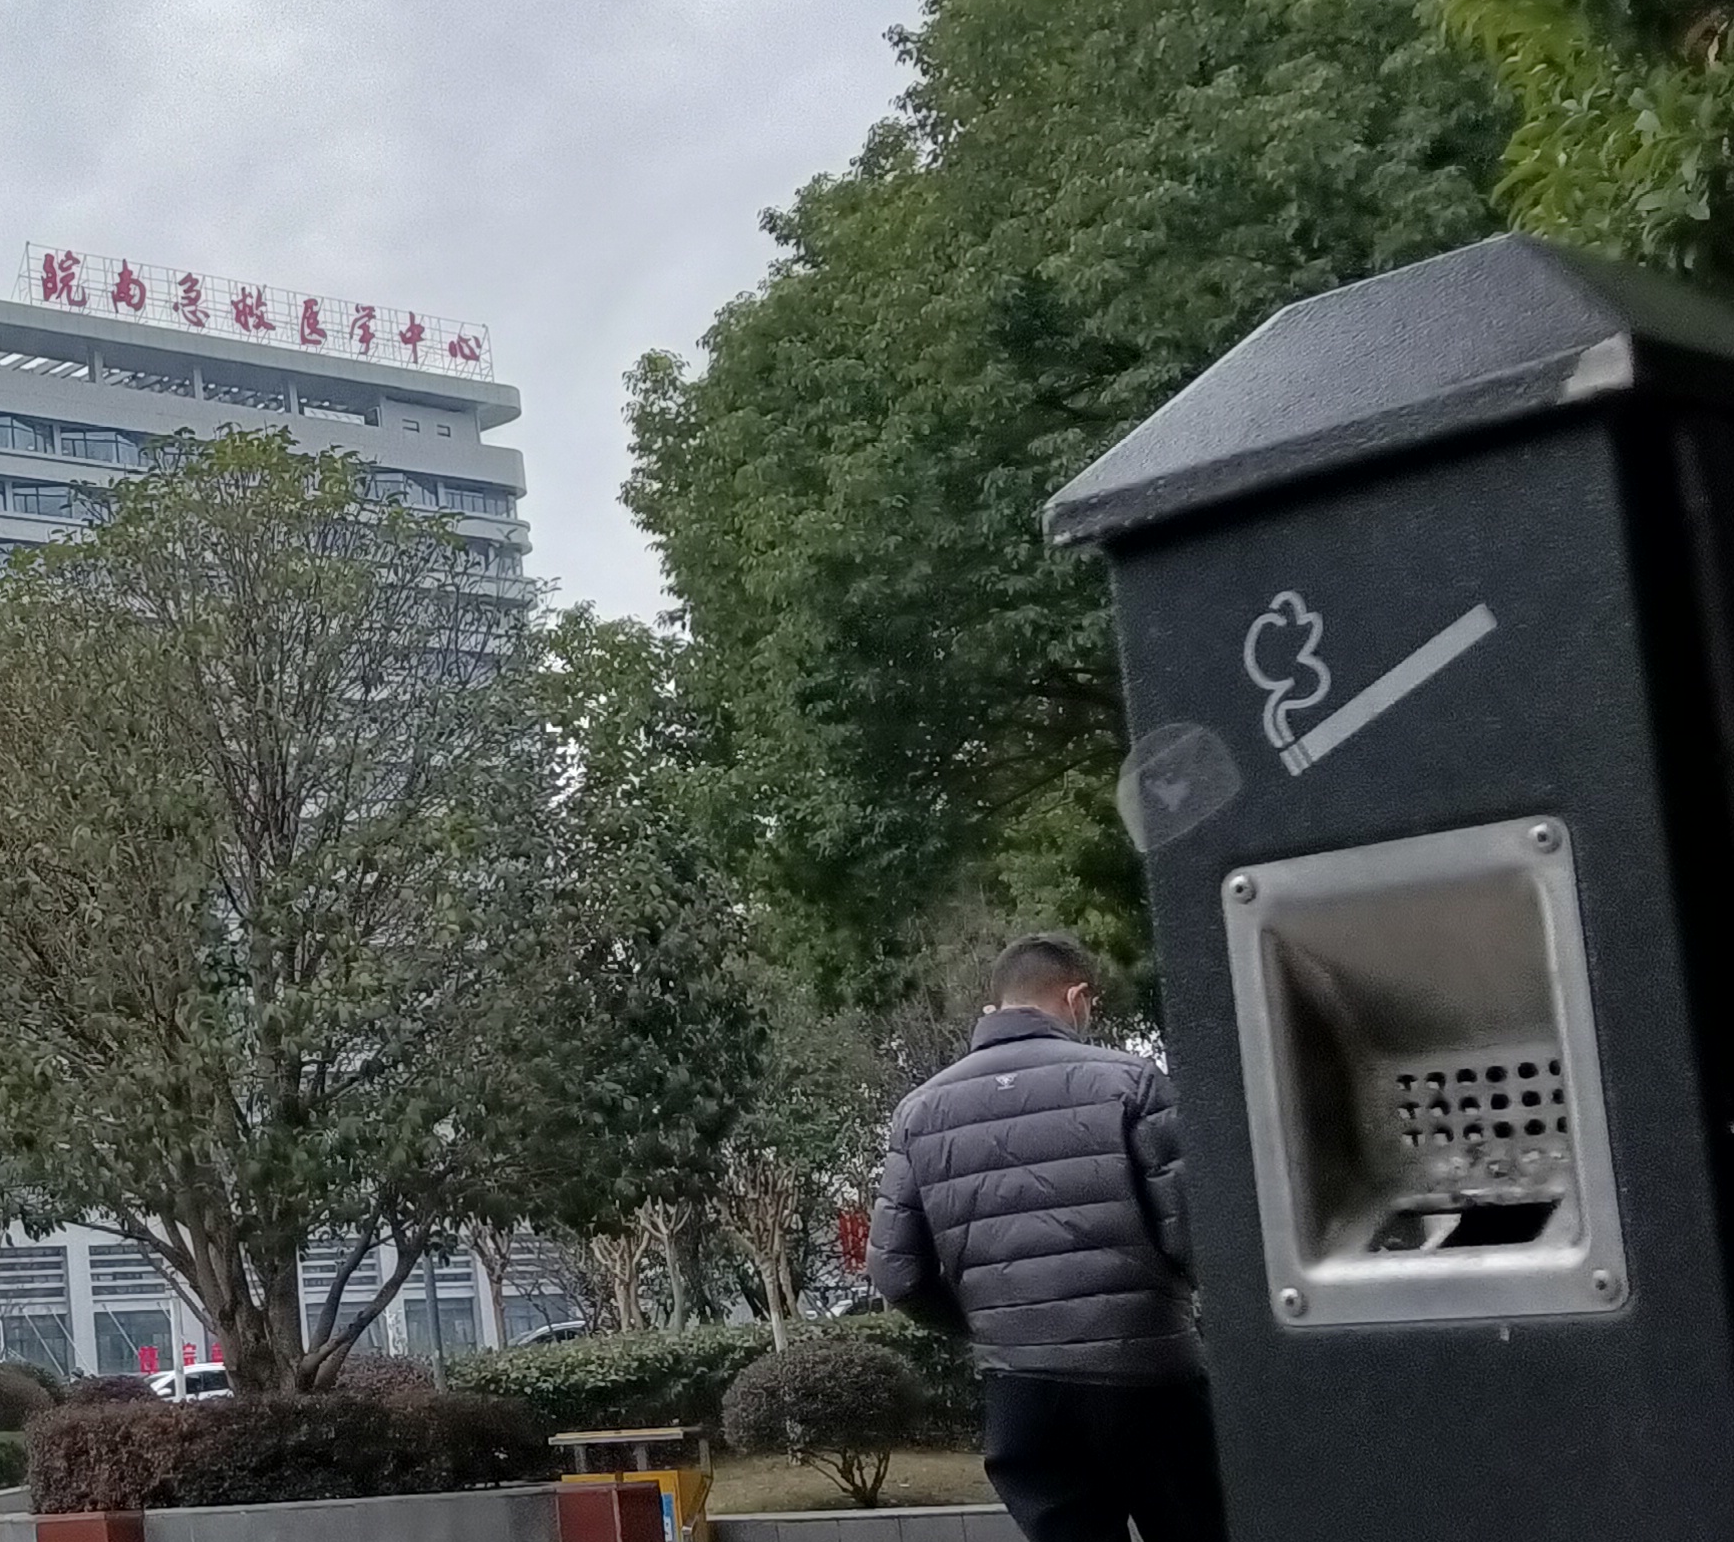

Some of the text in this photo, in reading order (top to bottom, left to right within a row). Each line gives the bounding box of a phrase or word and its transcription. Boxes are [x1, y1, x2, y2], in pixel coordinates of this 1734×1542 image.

[41, 249, 481, 364] 皖南急救医学中心
